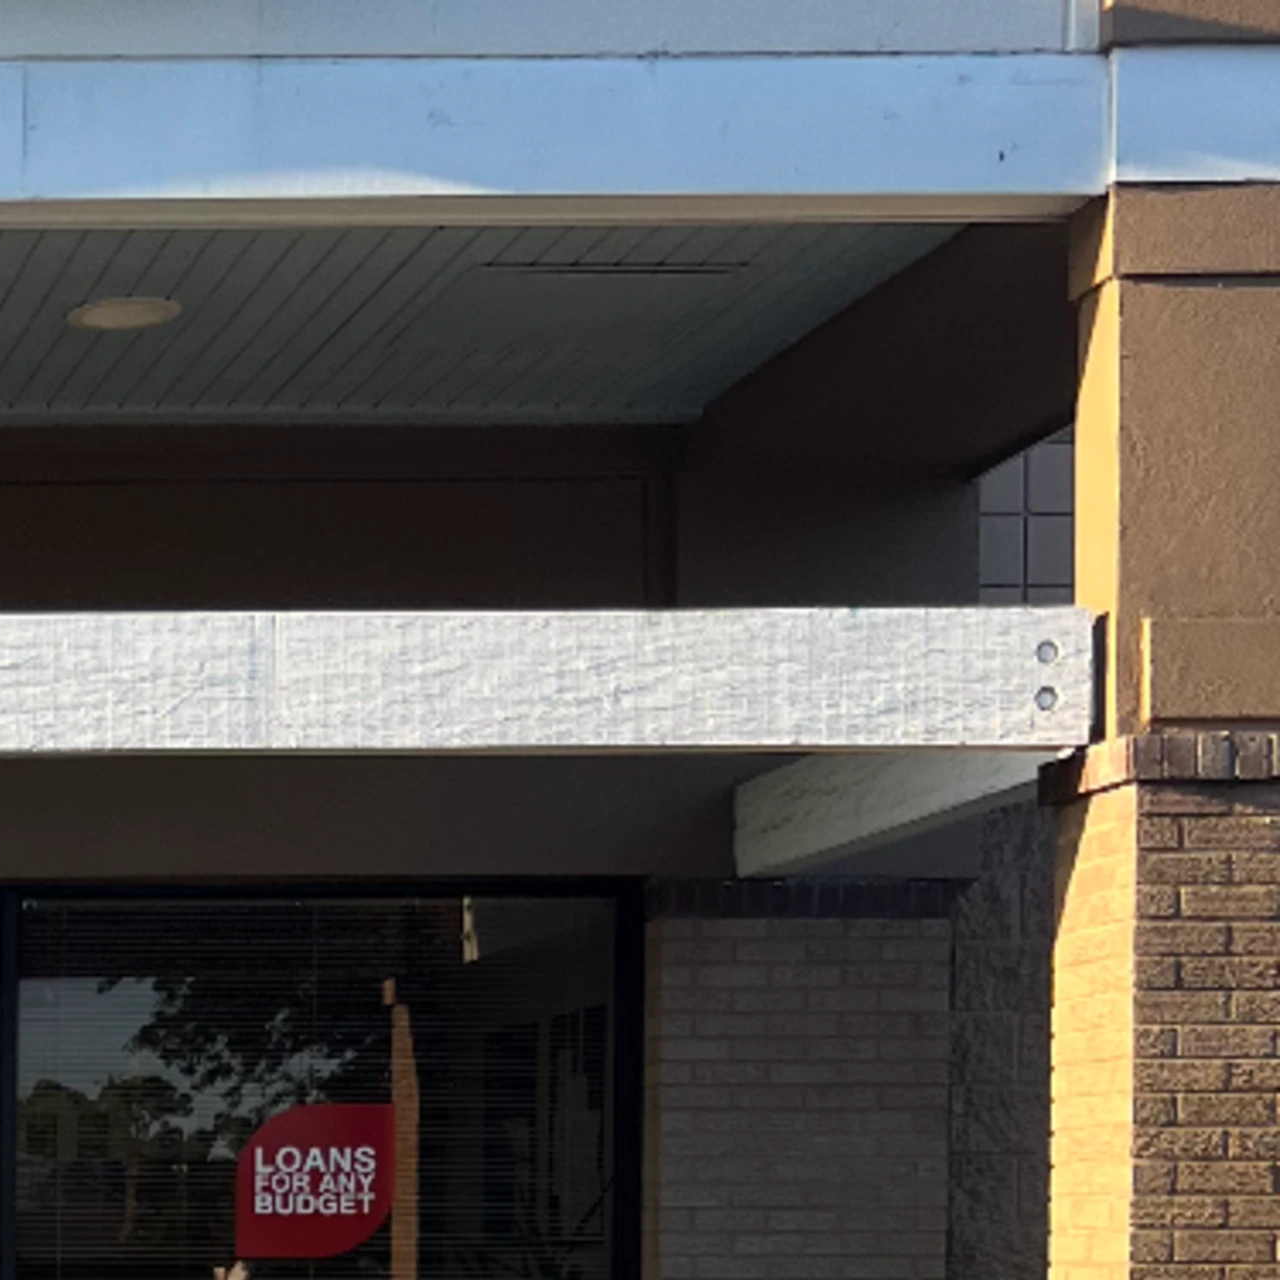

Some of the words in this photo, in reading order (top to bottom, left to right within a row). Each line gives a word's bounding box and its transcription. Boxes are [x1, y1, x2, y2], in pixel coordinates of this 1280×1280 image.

[254, 1147, 376, 1172] LOANS
[254, 1172, 310, 1194] FOR
[319, 1172, 375, 1193] ANY
[254, 1193, 376, 1215] BUDGET
